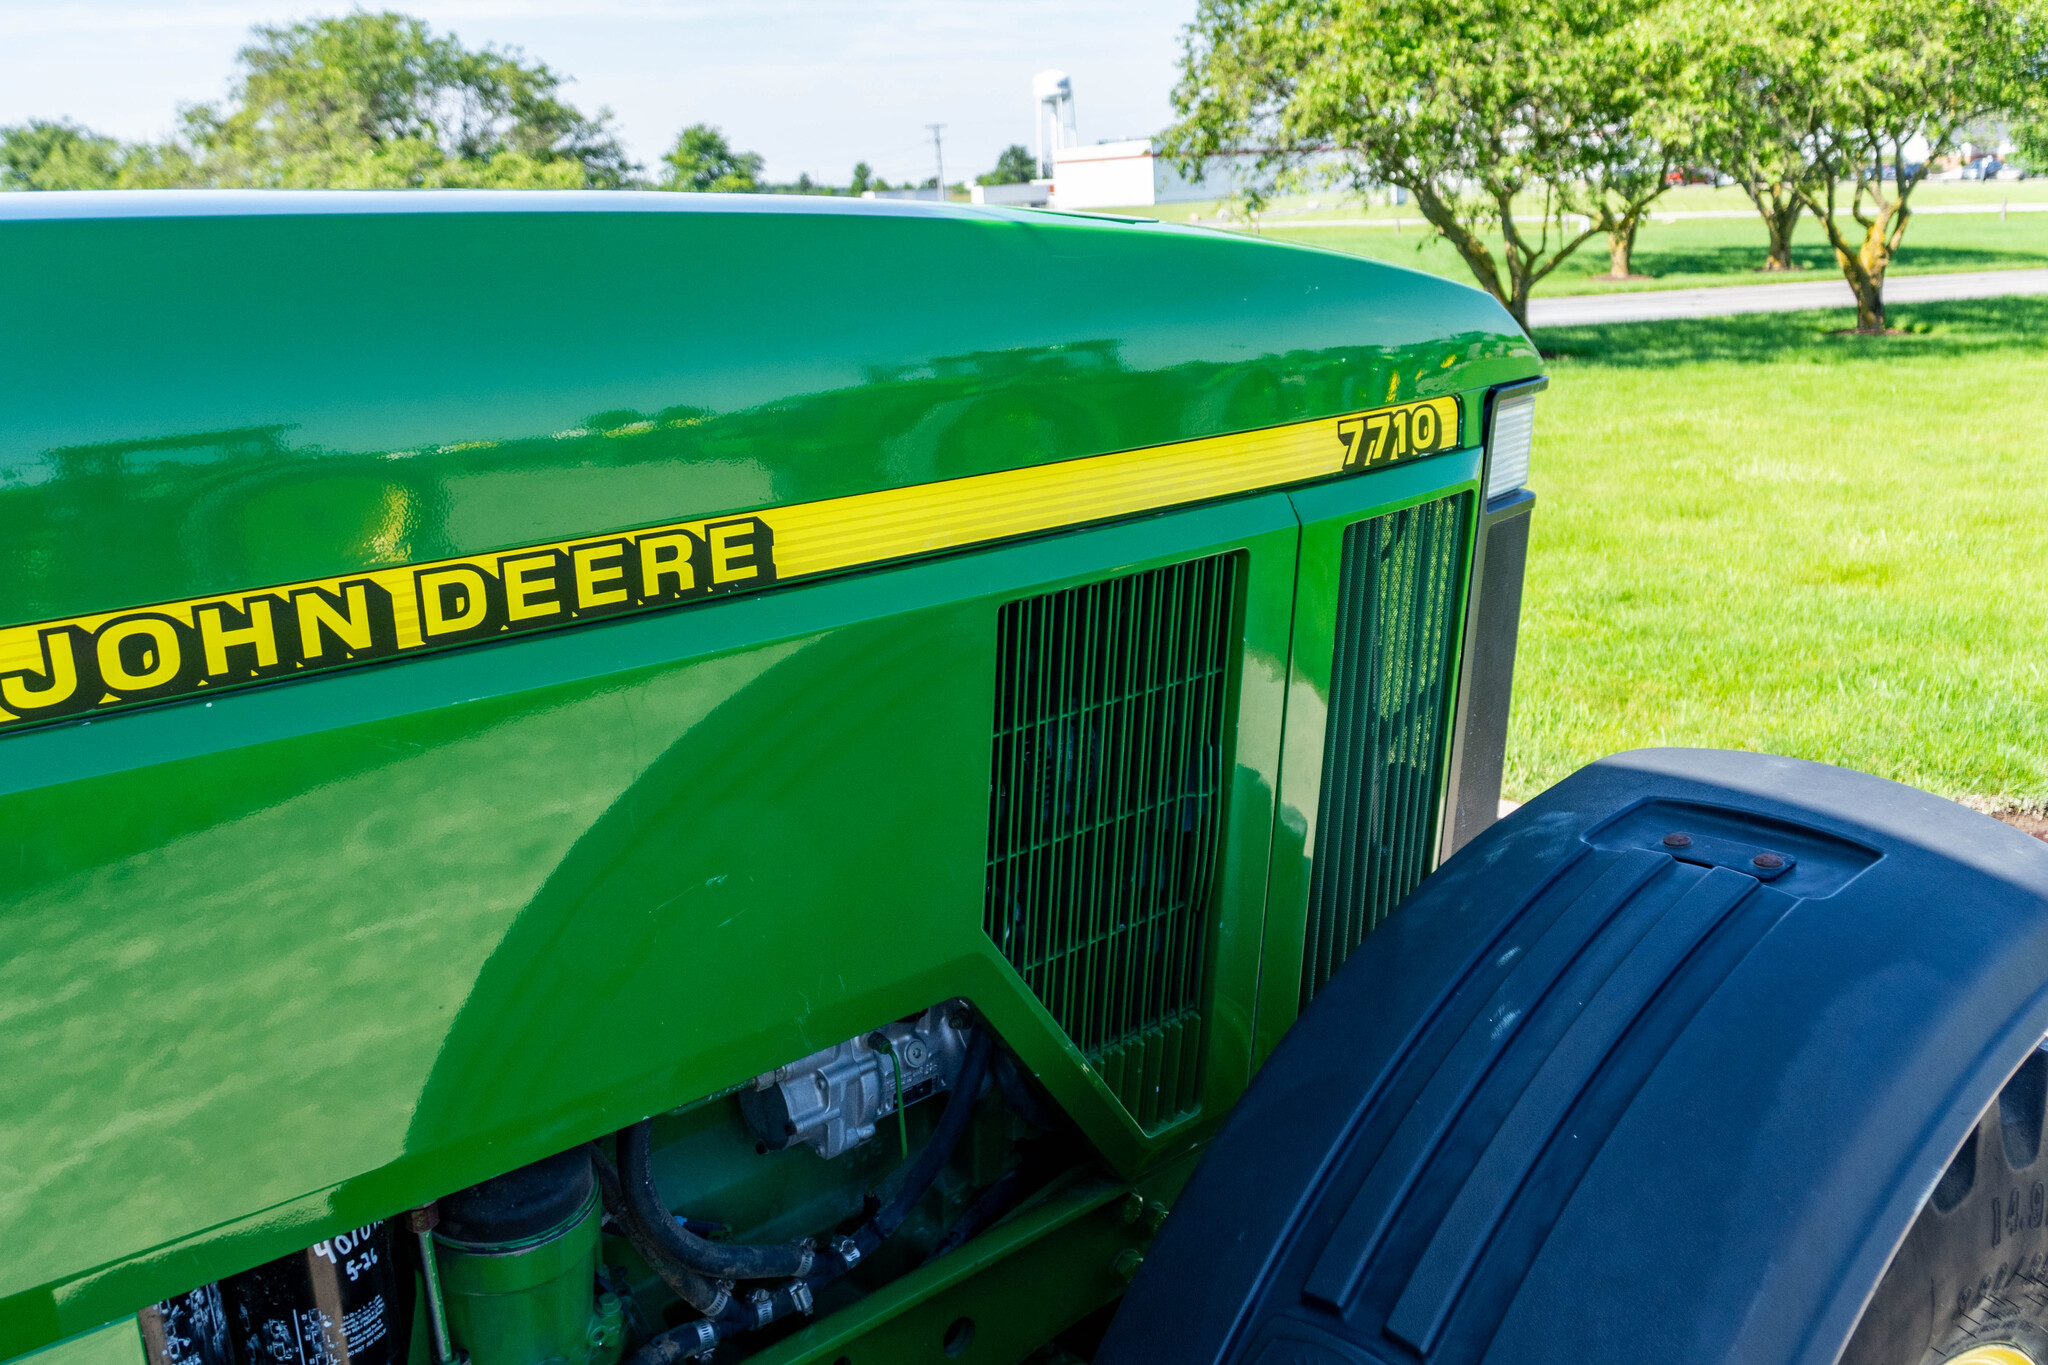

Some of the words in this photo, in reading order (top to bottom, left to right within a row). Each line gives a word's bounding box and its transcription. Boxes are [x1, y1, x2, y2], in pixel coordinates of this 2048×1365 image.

[1339, 404, 1437, 467] 7710
[0, 579, 375, 711] JOHN
[418, 519, 762, 638] DEERE
